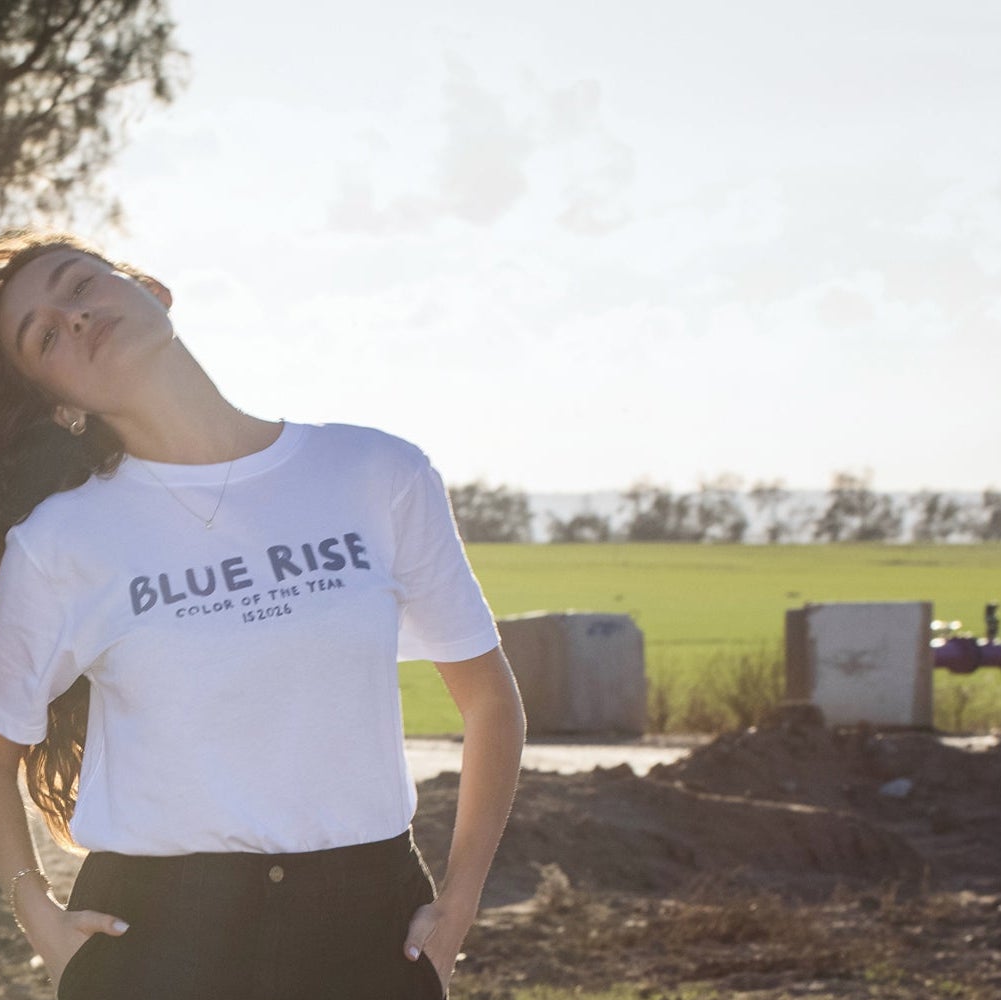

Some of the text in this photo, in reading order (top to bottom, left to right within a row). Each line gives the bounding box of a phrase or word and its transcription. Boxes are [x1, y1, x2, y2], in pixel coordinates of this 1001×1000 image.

[129, 532, 371, 616] BLUE RISE
[175, 578, 345, 618] COLOR OF THE YEAR
